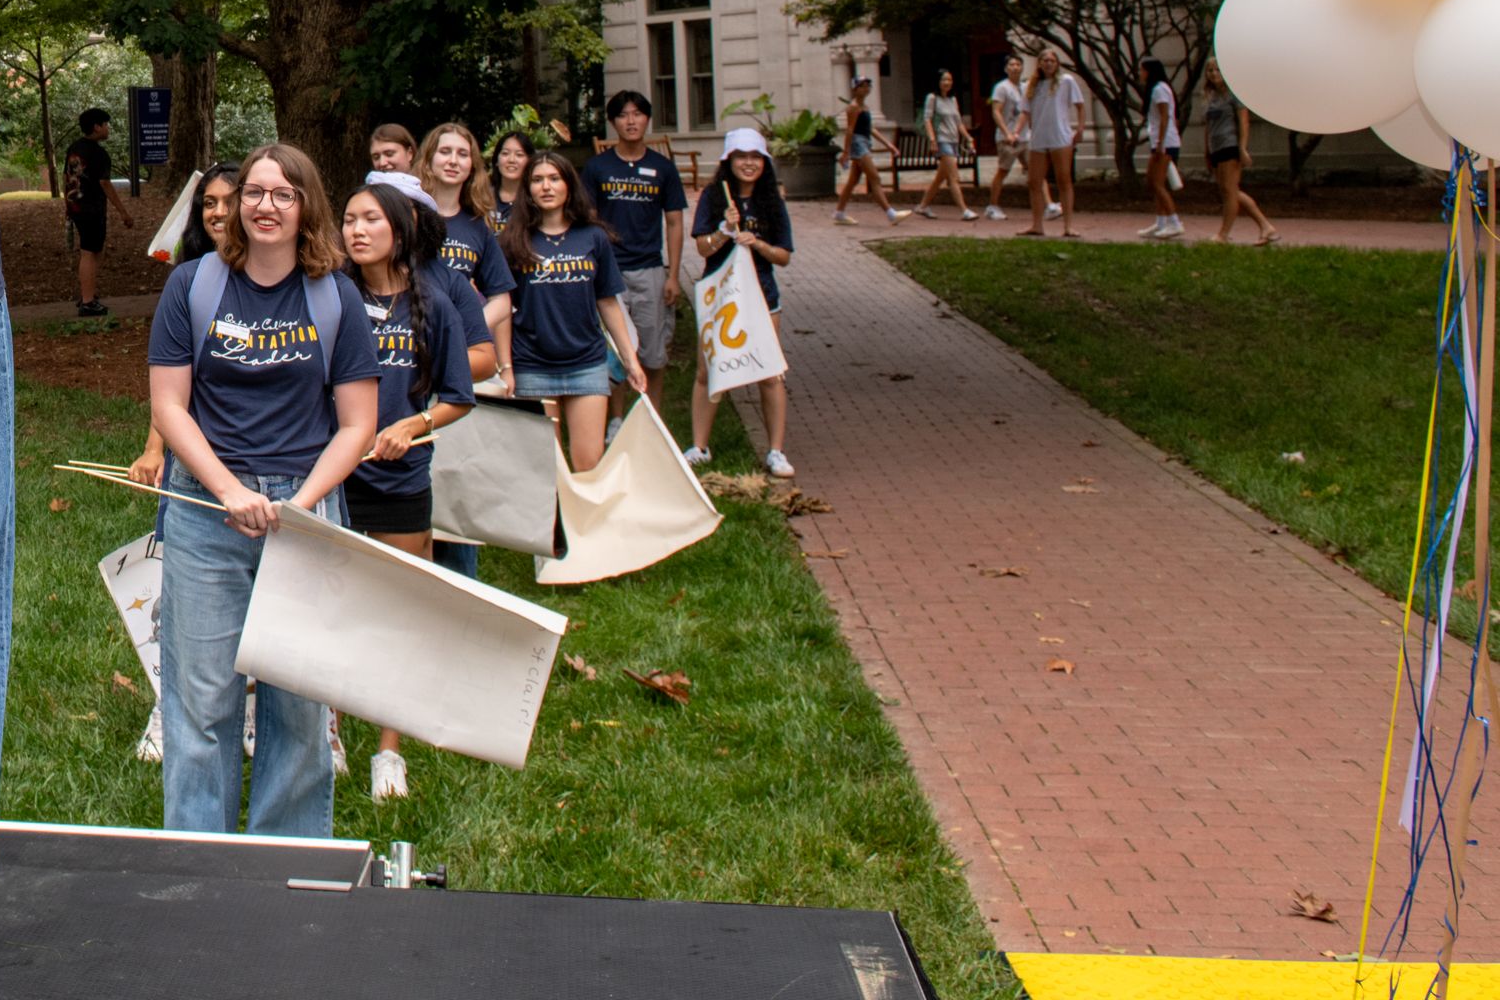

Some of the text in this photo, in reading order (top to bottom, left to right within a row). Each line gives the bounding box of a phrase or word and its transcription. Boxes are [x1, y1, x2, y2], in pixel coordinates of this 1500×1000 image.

[441, 247, 478, 263] TATION
[529, 268, 590, 284] Leader
[210, 337, 312, 366] Leader
